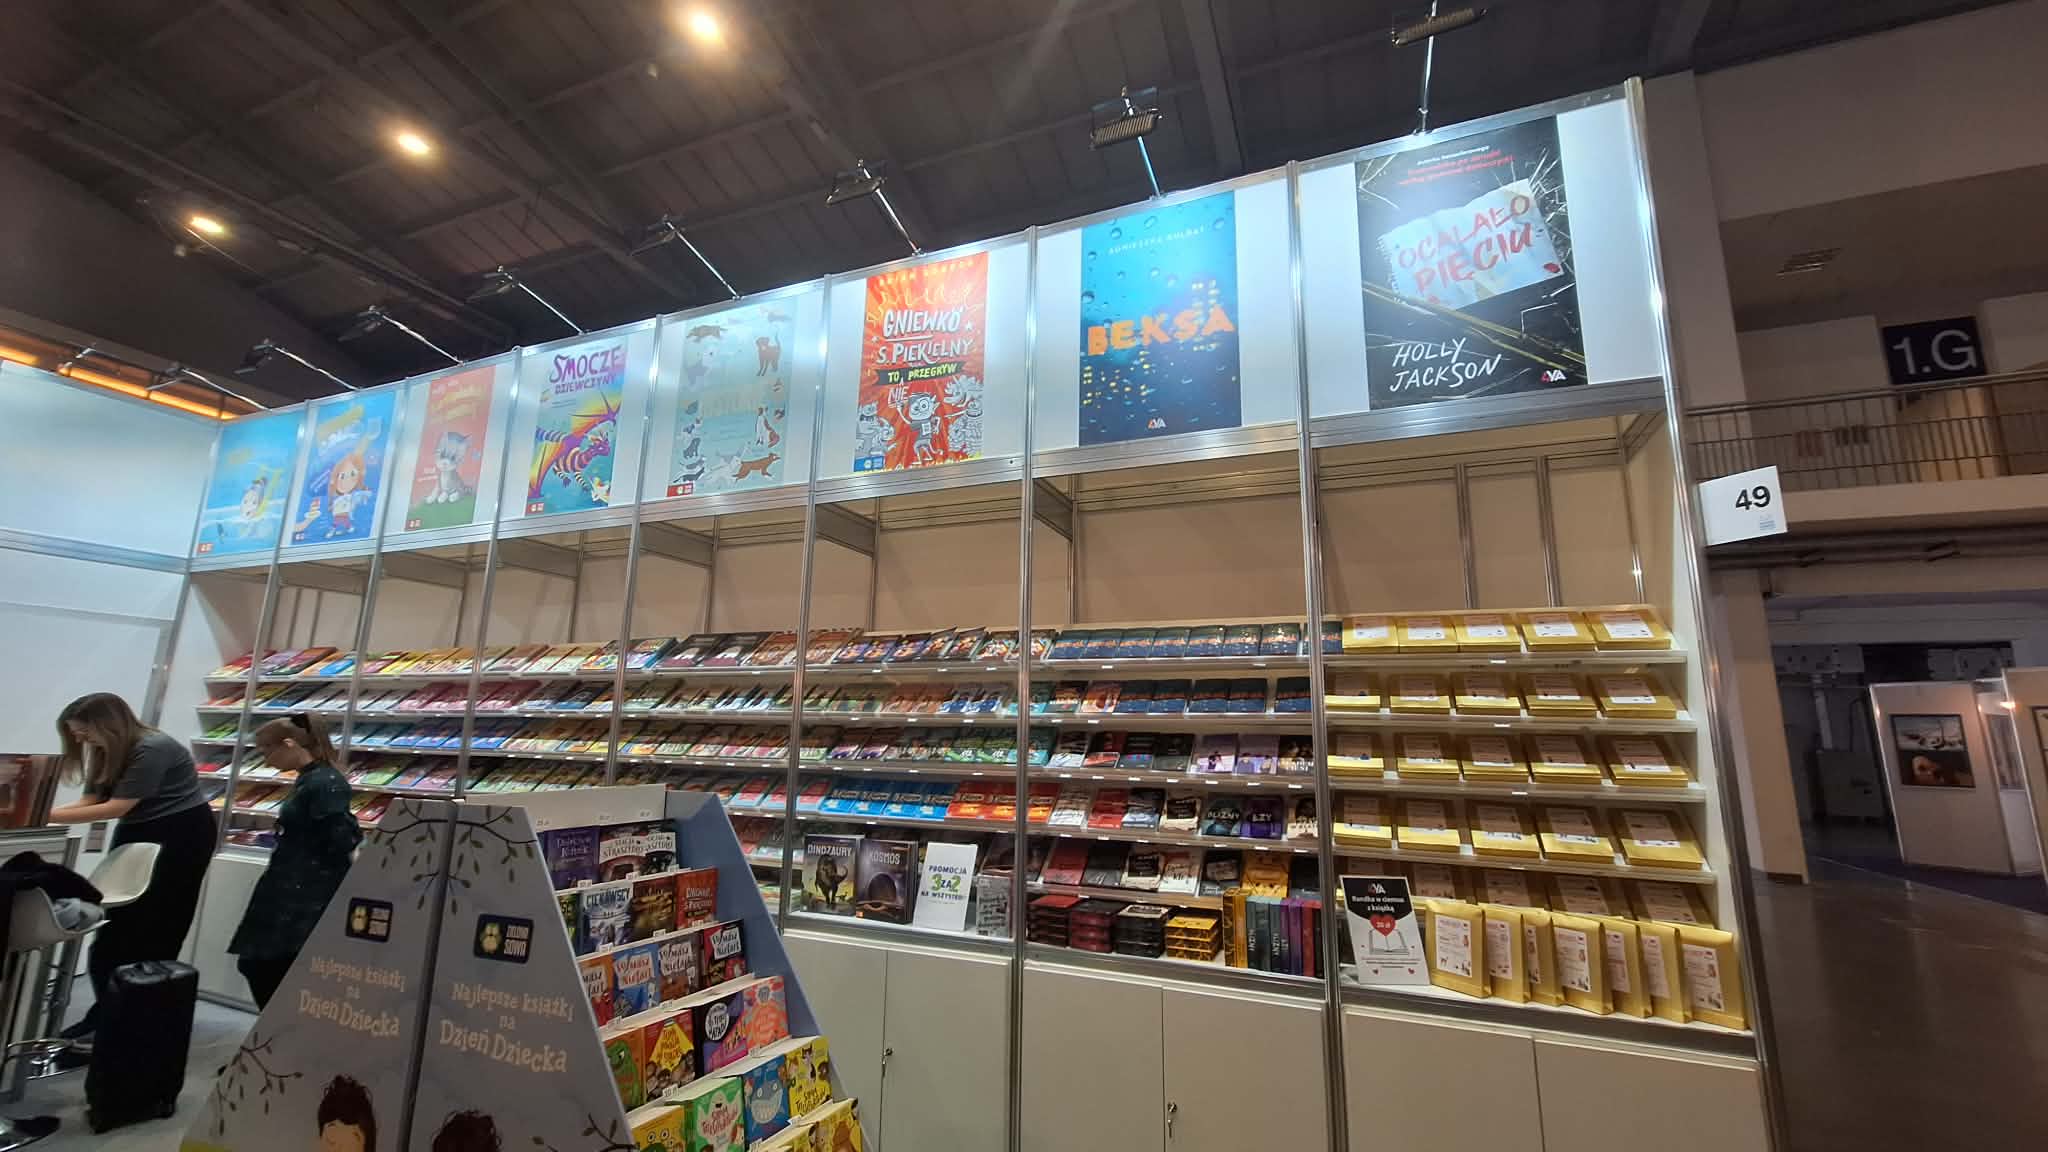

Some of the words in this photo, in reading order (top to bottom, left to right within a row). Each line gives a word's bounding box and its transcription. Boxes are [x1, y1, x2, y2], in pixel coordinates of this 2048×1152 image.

[1415, 221, 1534, 296] PIĘCIU
[1087, 303, 1236, 357] BEKSA
[549, 344, 626, 384] SMOCZE
[1392, 336, 1467, 368] HOLLY
[1892, 330, 1978, 375] 1.G
[555, 373, 620, 395] DZIEWCZYNY
[888, 371, 901, 383] TO
[907, 363, 958, 381] PRZEGRYW
[1389, 353, 1503, 393] JACKSON
[1736, 485, 1771, 510] 49
[807, 844, 852, 857] DINOZAURY
[871, 848, 901, 865] KOSMOS
[928, 865, 967, 875] PROMOCJA
[299, 989, 337, 1021] Dzień
[336, 1001, 401, 1037] Dziecka
[451, 983, 519, 1011] Najlepsze
[522, 993, 576, 1022] książki
[499, 1015, 516, 1031] na
[440, 1018, 489, 1055] Dzień
[490, 1033, 568, 1072] Dziecka
